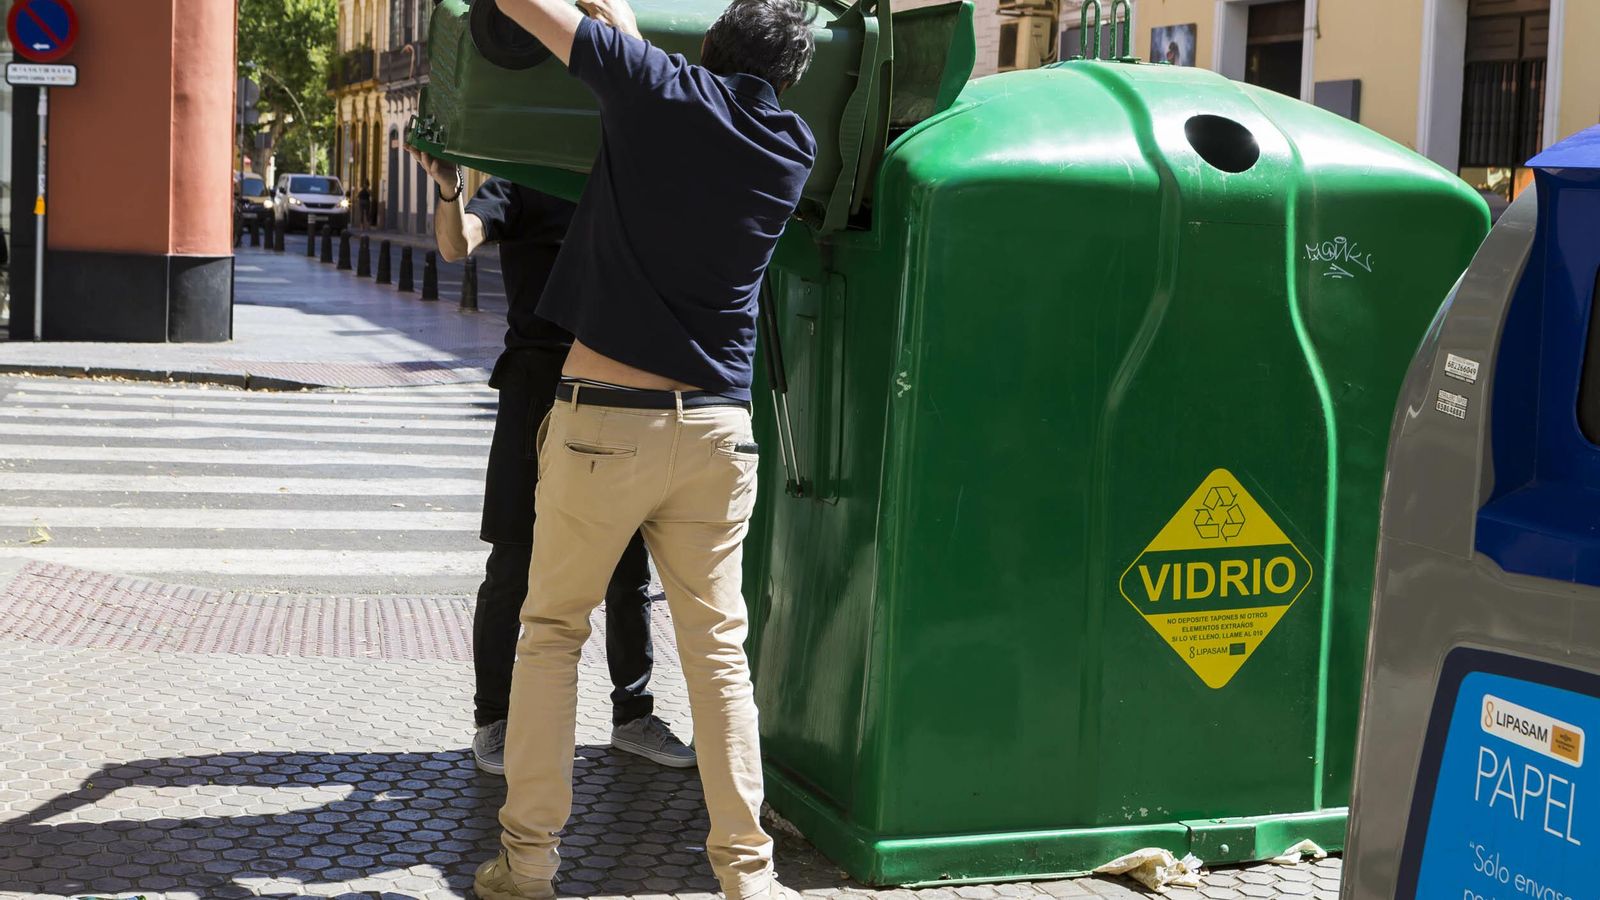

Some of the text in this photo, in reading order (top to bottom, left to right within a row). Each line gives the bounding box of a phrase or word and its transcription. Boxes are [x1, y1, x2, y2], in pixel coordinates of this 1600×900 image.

[1138, 556, 1296, 602] VIDRIO
[1178, 615, 1208, 623] DEPOSITE
[1210, 613, 1239, 621] TAPONES
[1248, 611, 1269, 619] OTROS
[1182, 621, 1254, 633] ELEMENTOS EXTRAÑOS
[1190, 634, 1198, 642] VE
[1223, 631, 1244, 640] LLAME
[1254, 629, 1264, 637] 010
[1197, 647, 1229, 656] LIPASAM
[1496, 710, 1549, 743] LIPASAM
[1474, 745, 1582, 846] PAPEL
[1514, 873, 1573, 900] envas
